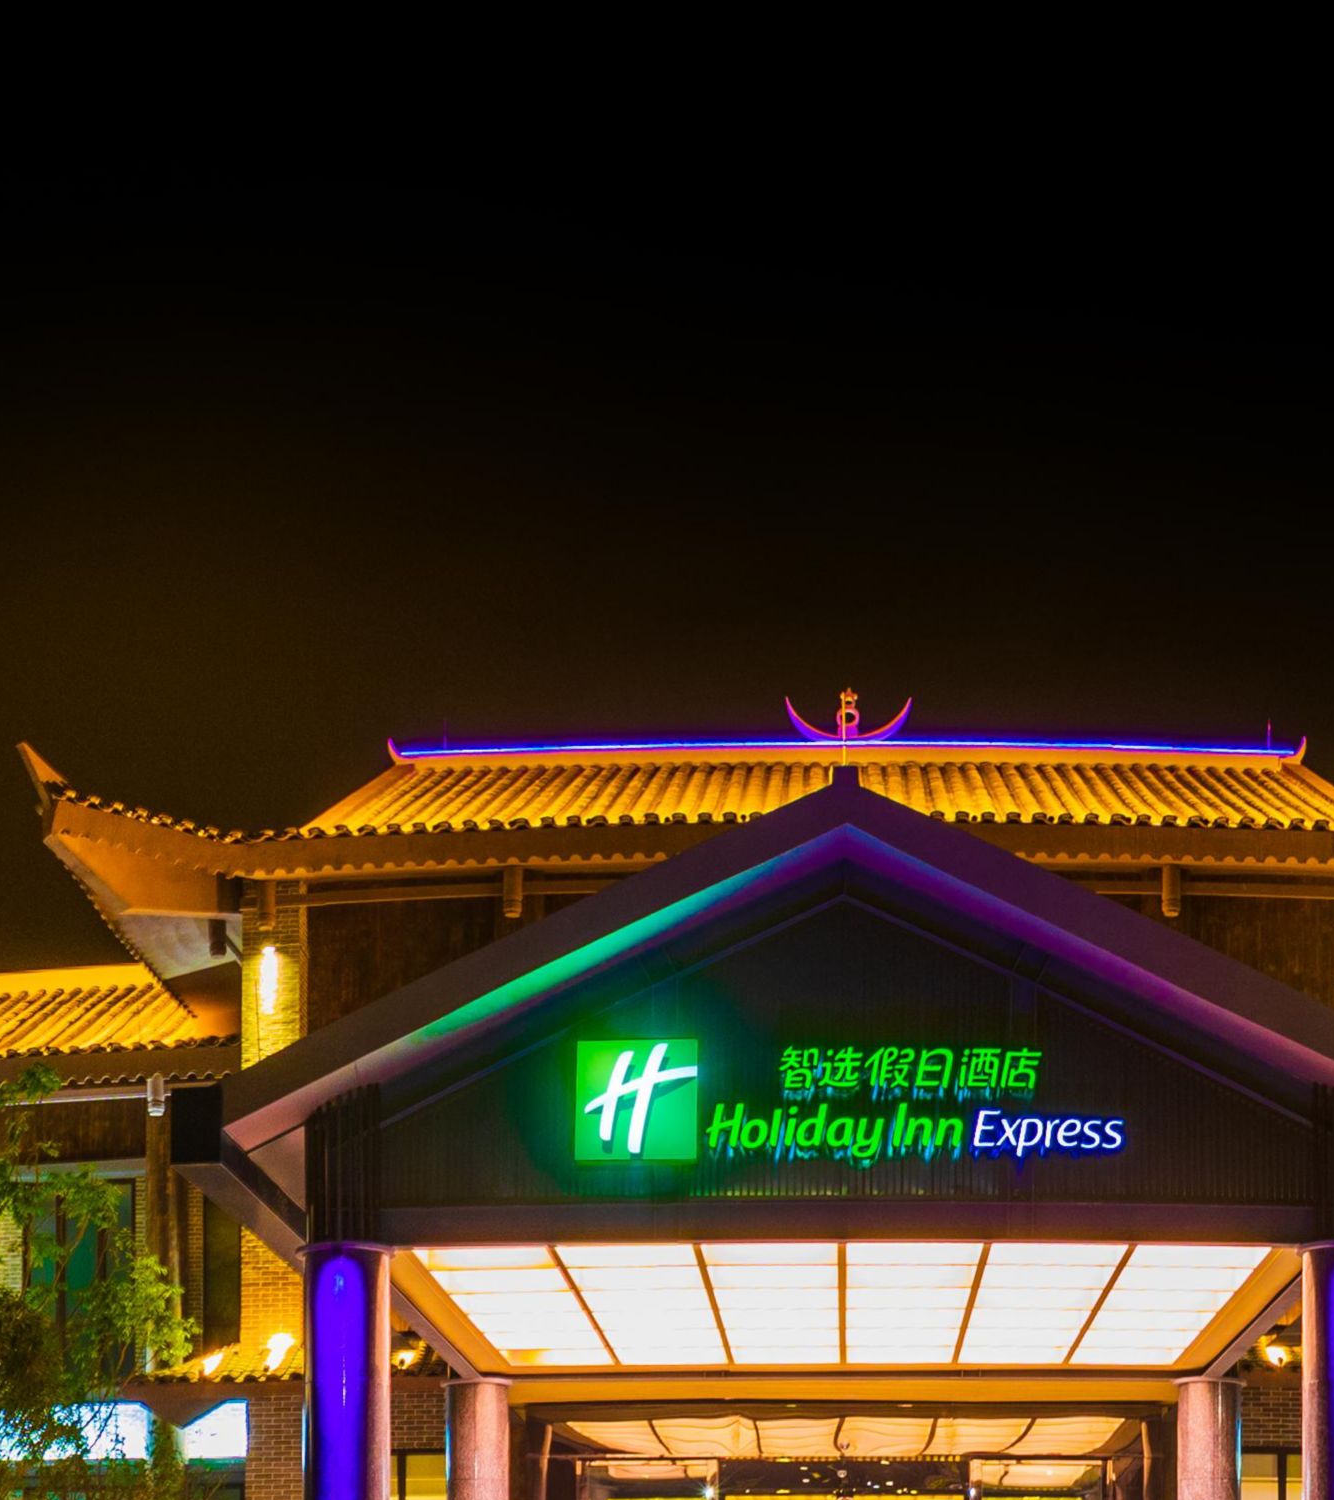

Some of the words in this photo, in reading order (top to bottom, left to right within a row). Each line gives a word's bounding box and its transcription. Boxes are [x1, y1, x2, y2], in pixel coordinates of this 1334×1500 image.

[779, 1046, 1042, 1089] 智选假日酒店
[706, 1103, 885, 1157] Holiday
[892, 1103, 963, 1149] Inn
[975, 1110, 1124, 1156] Express
